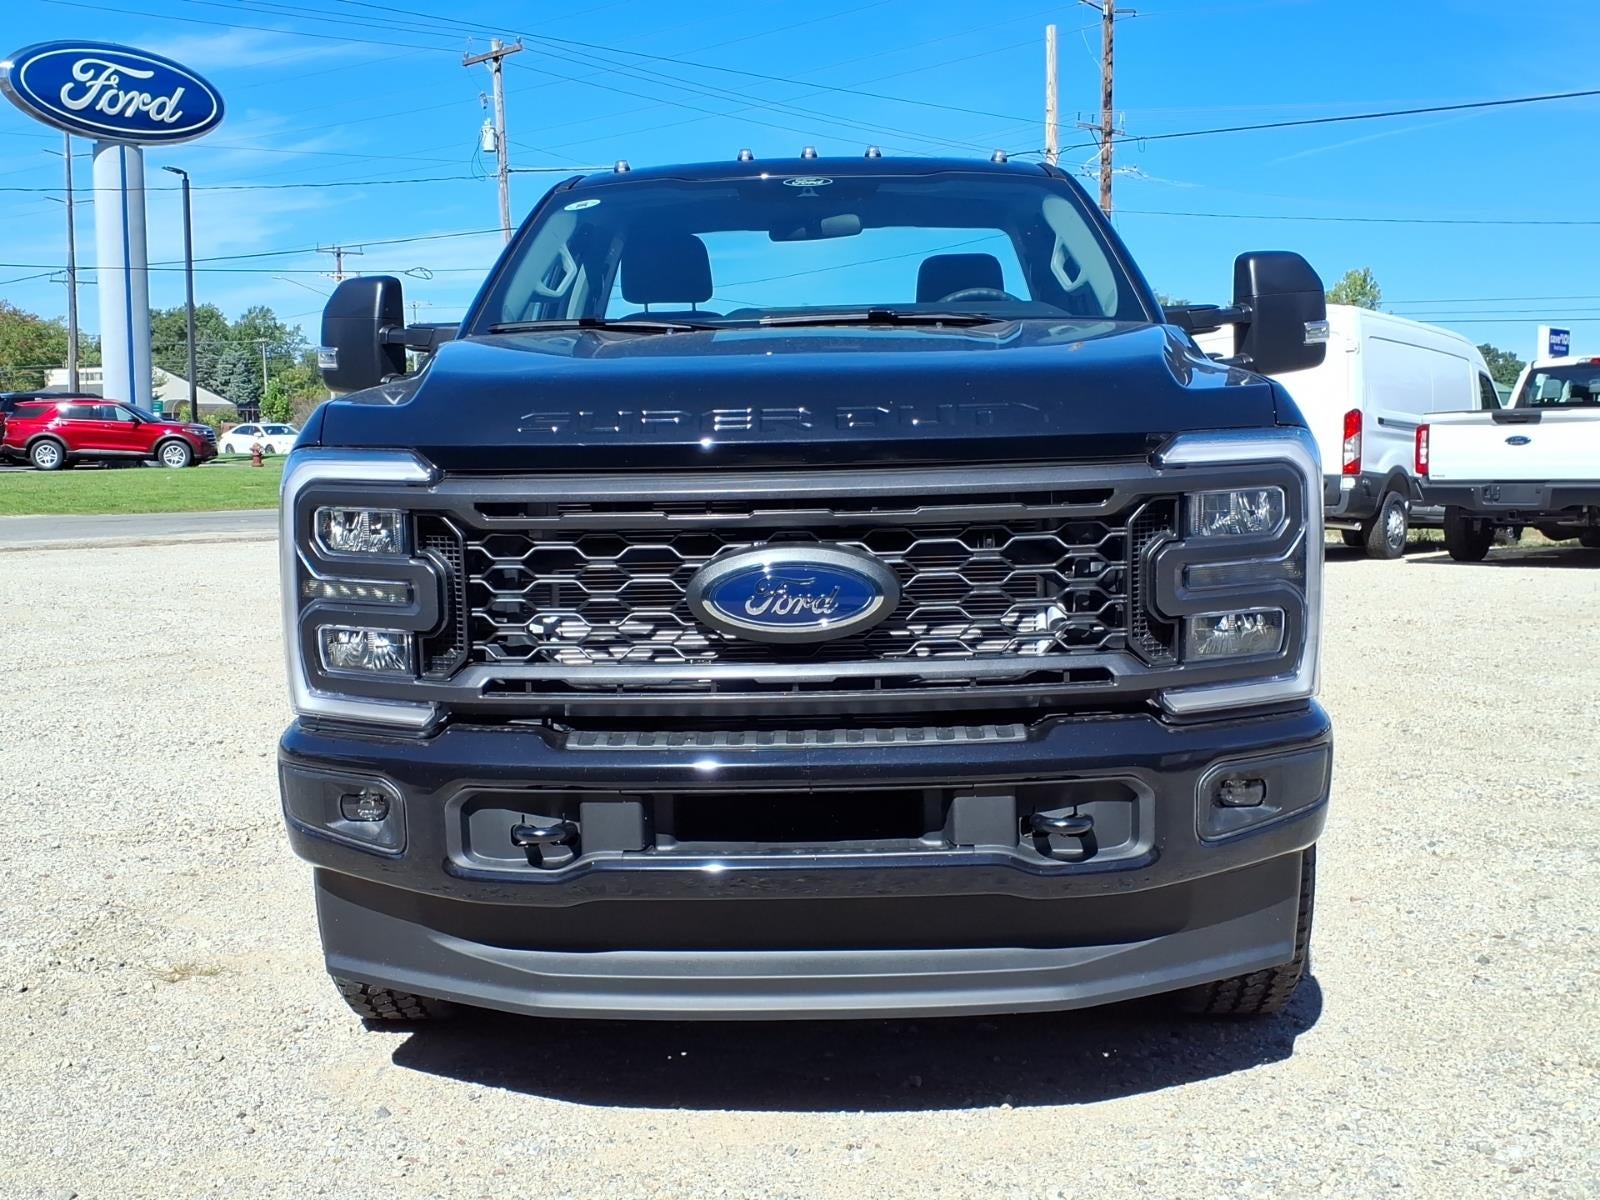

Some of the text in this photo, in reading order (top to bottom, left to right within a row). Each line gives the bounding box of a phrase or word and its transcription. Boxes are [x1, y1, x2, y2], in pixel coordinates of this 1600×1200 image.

[60, 58, 185, 123] Ford
[516, 408, 813, 434] SUPER
[744, 575, 841, 616] Ford
